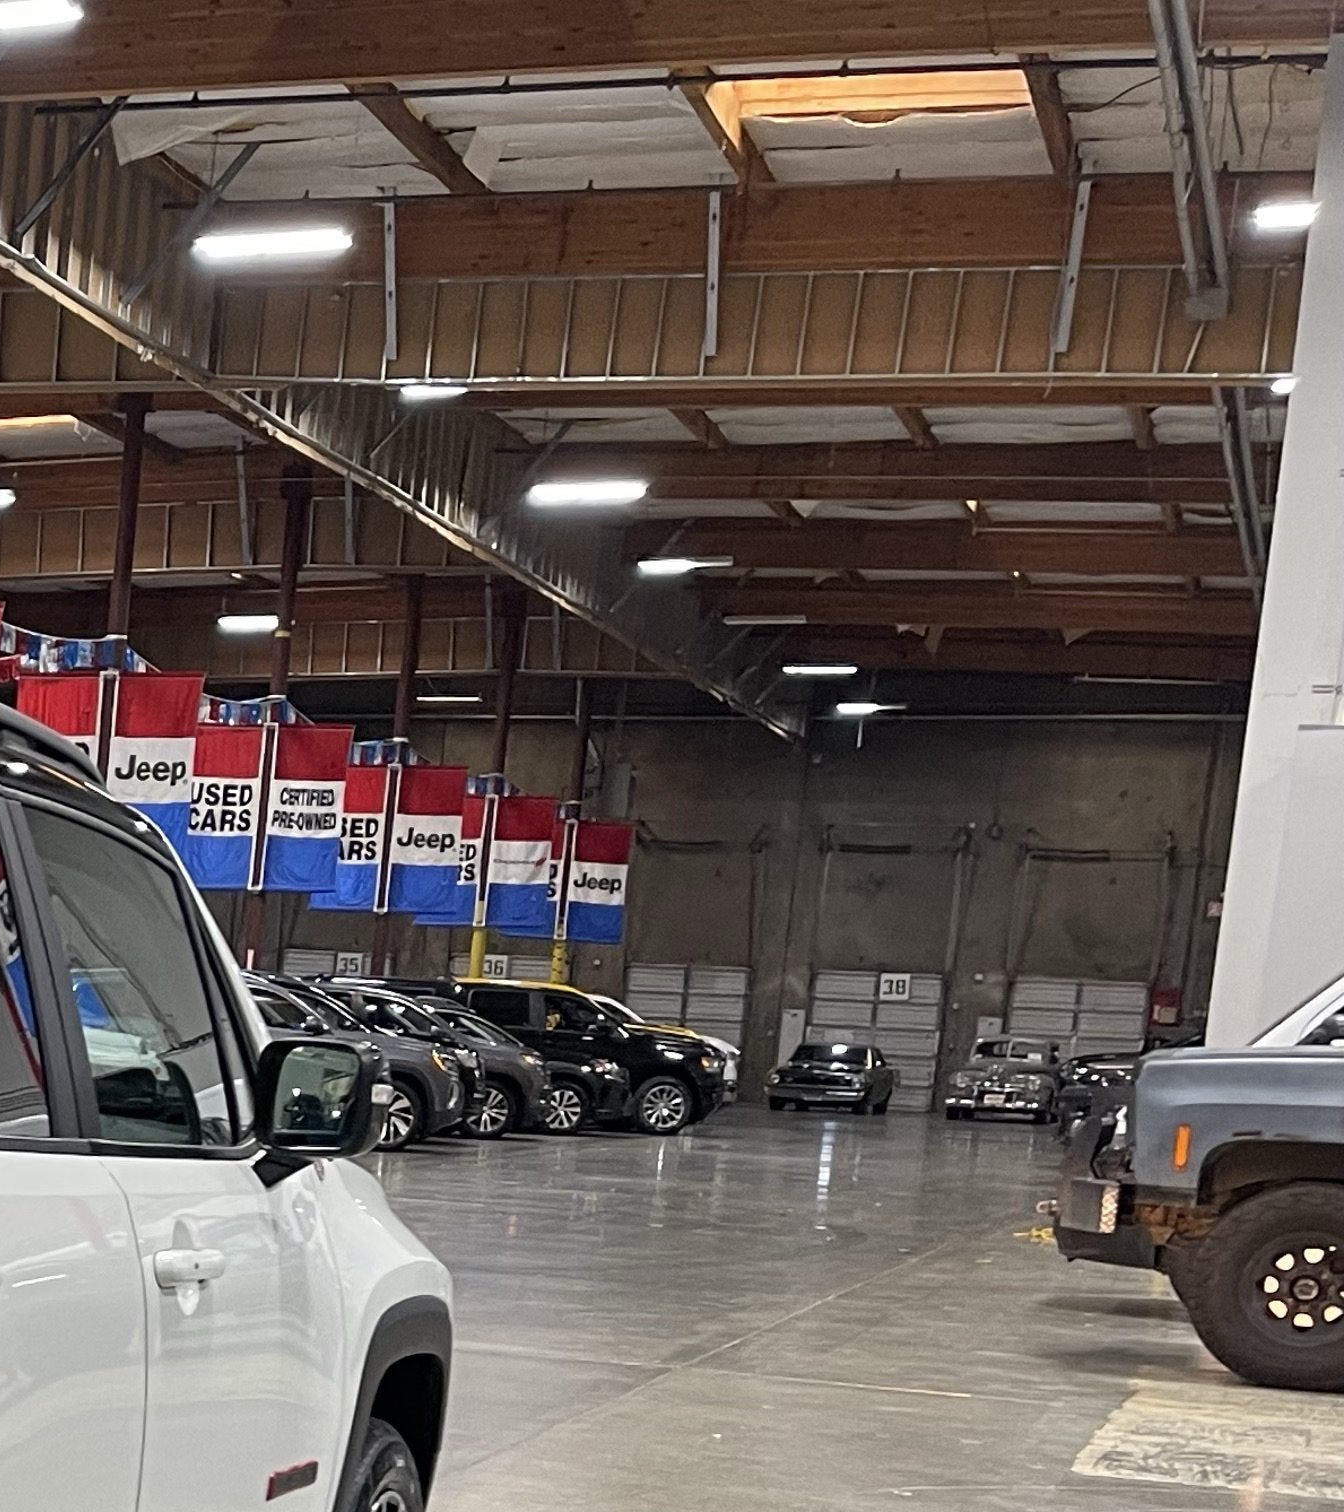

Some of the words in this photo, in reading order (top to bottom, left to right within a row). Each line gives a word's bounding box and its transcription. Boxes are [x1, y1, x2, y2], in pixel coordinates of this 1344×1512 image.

[114, 754, 187, 786] Jeep
[191, 782, 253, 807] USED
[279, 787, 335, 807] CERTIFIED
[188, 807, 252, 832] CARS
[271, 810, 337, 831] PRE-OWNED
[396, 826, 456, 853] Jeep
[572, 871, 623, 895] Jeep
[338, 957, 359, 973] 35
[882, 979, 906, 995] 38
